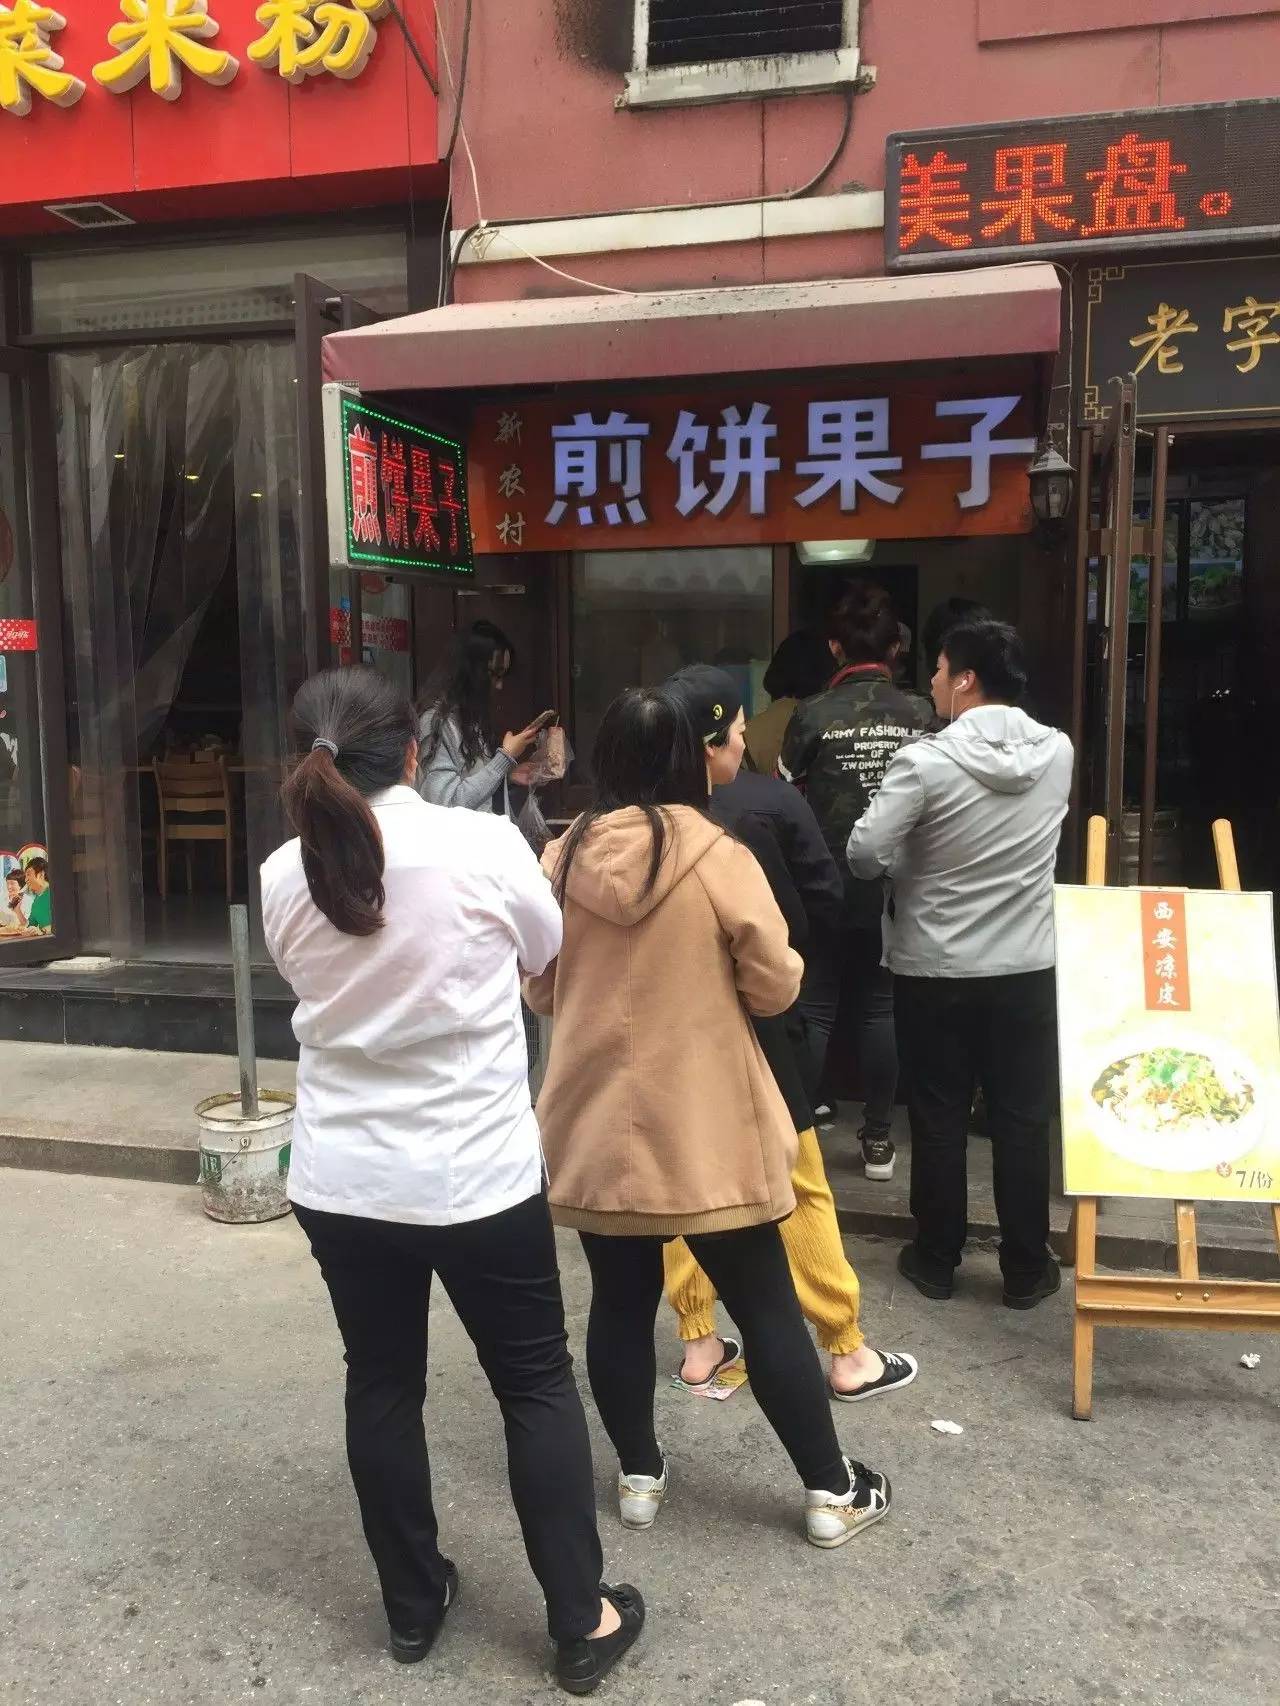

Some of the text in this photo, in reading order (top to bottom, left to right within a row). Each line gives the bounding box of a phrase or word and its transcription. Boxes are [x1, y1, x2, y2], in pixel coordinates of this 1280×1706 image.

[1129, 296, 1280, 373] 老字
[544, 395, 1037, 526] 煎饼果子
[348, 423, 462, 554] 煎饼果子
[822, 728, 856, 740] ARMY
[853, 741, 900, 752] PROPERTY
[870, 749, 884, 759] OF
